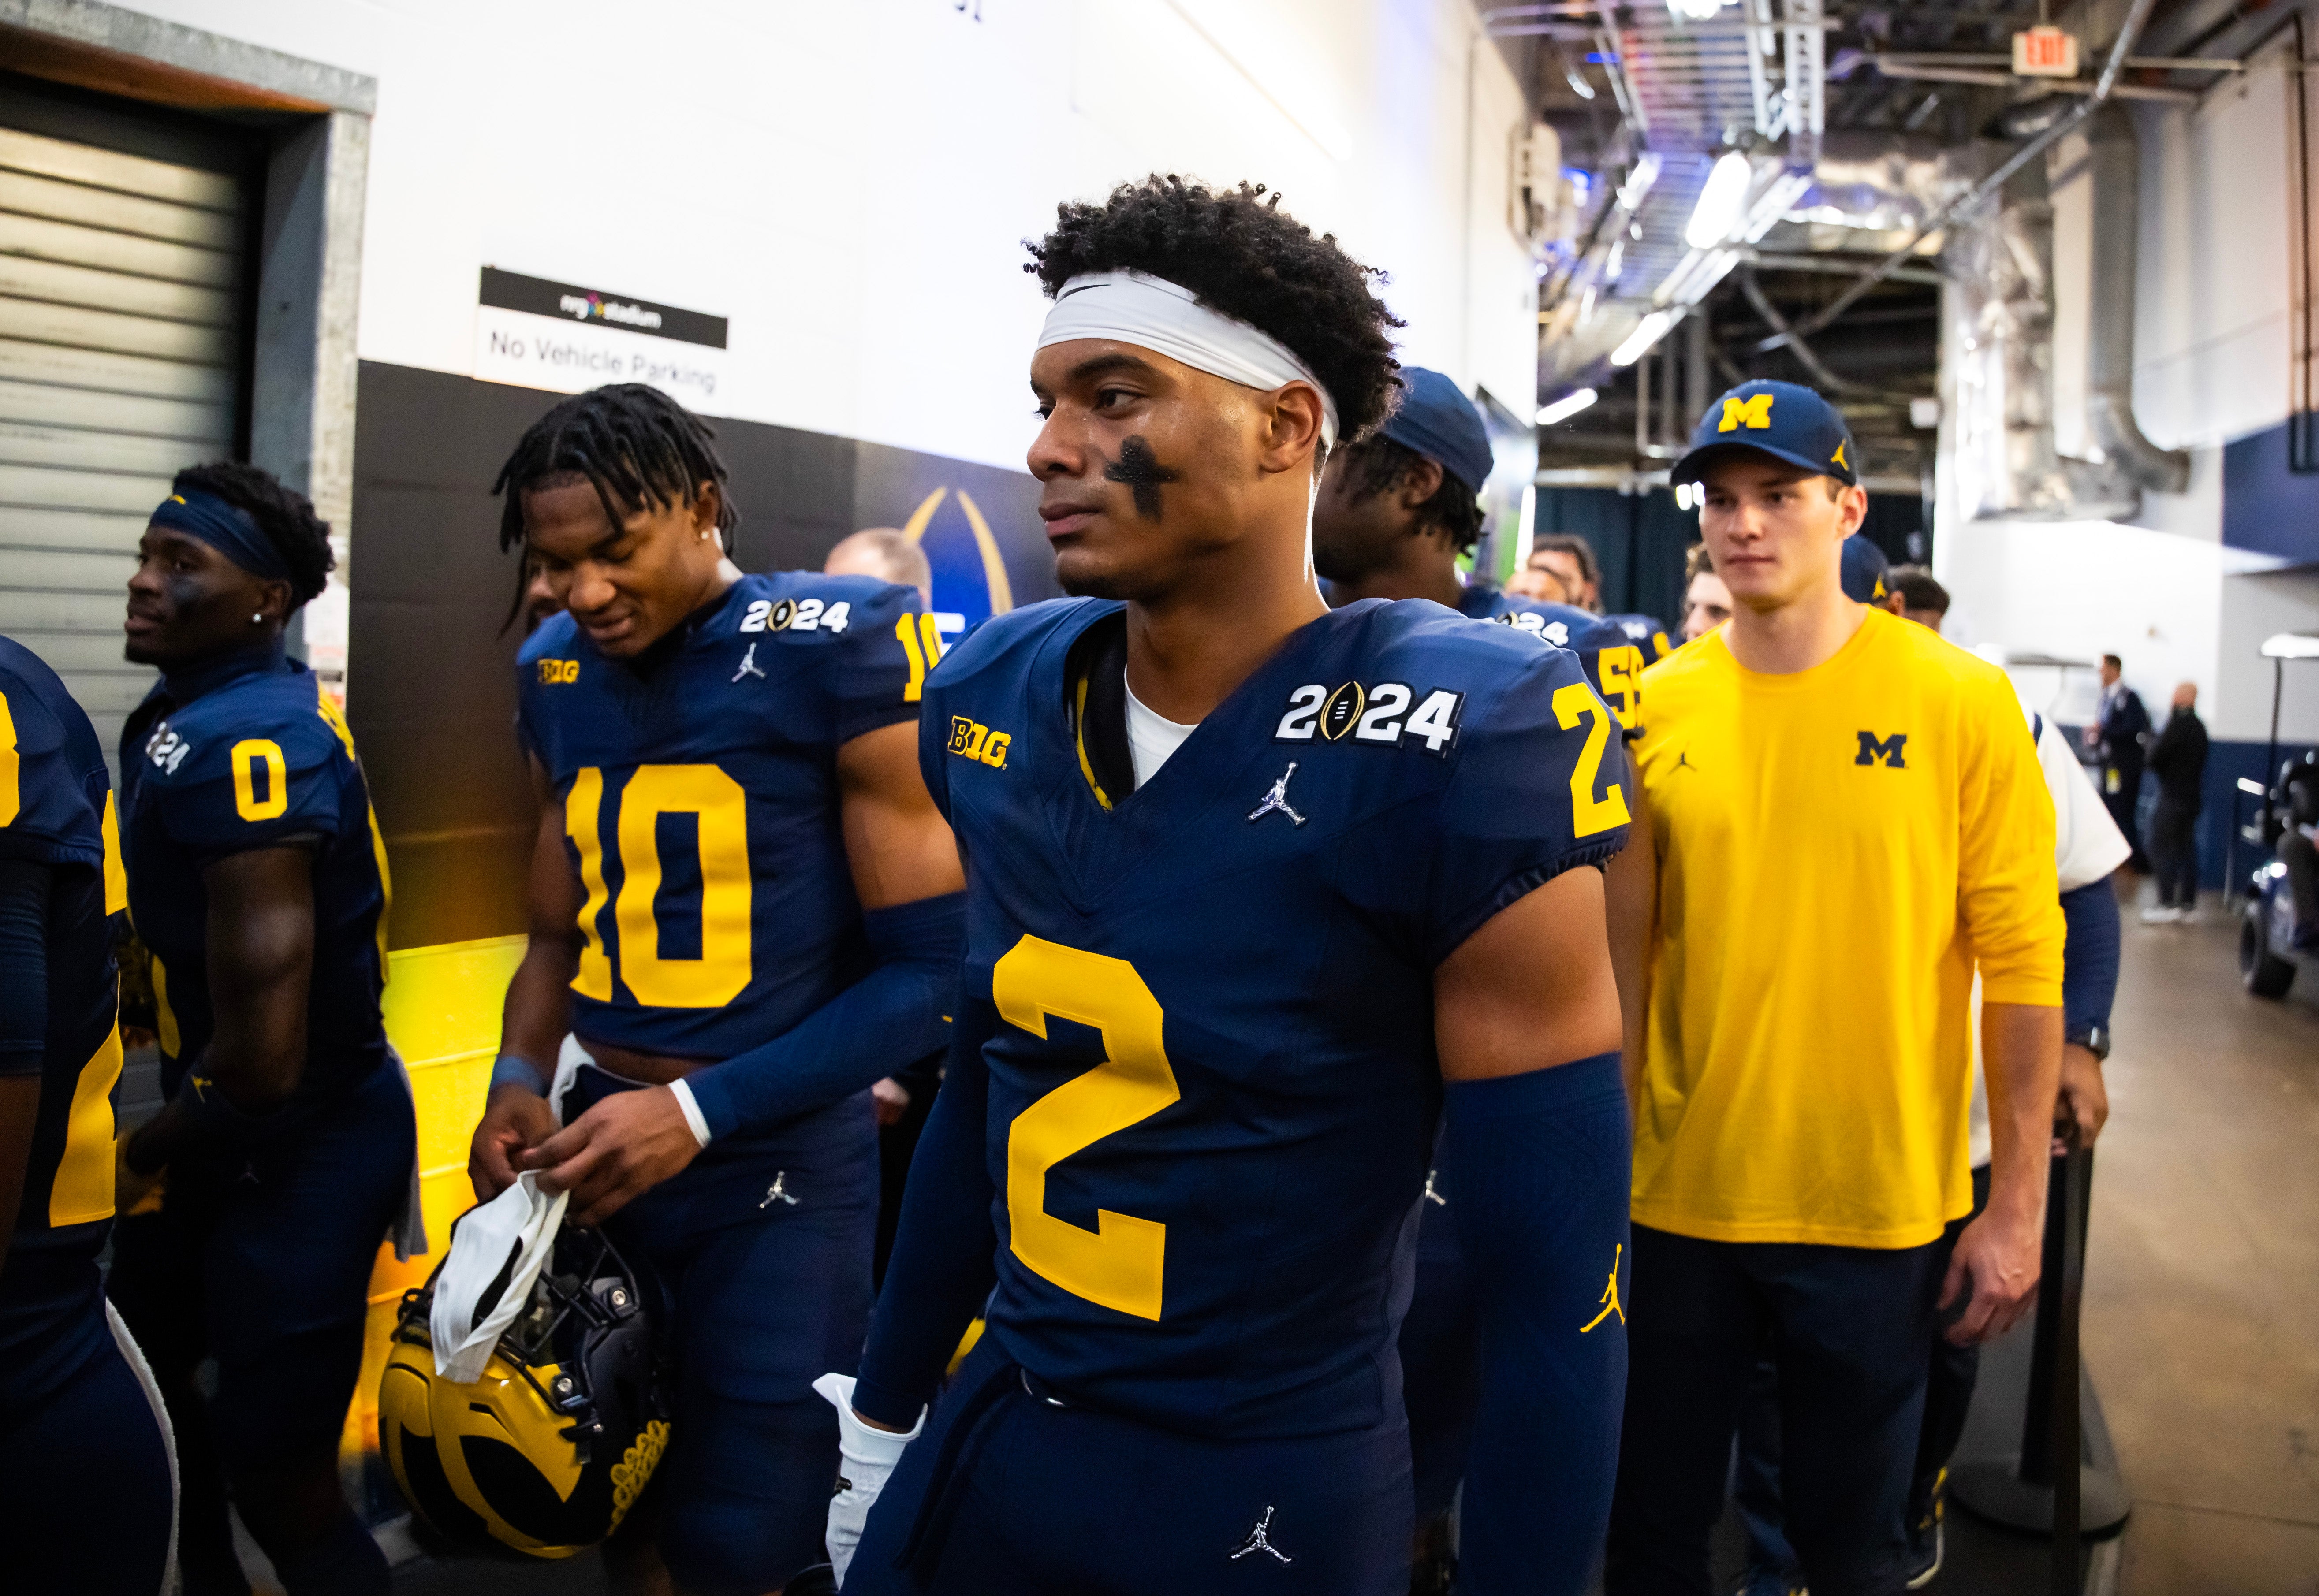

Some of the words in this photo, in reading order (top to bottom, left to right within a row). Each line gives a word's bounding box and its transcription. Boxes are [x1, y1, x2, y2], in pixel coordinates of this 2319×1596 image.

[490, 330, 525, 359] No
[535, 337, 623, 375] Vehicle
[632, 354, 717, 394] Parking
[1719, 394, 1774, 432] M
[1481, 610, 1569, 646] 24
[231, 739, 287, 822] 0
[1552, 682, 1631, 839] 2
[1855, 731, 1907, 768] M
[566, 764, 753, 1008] 10
[993, 934, 1181, 1322] 2
